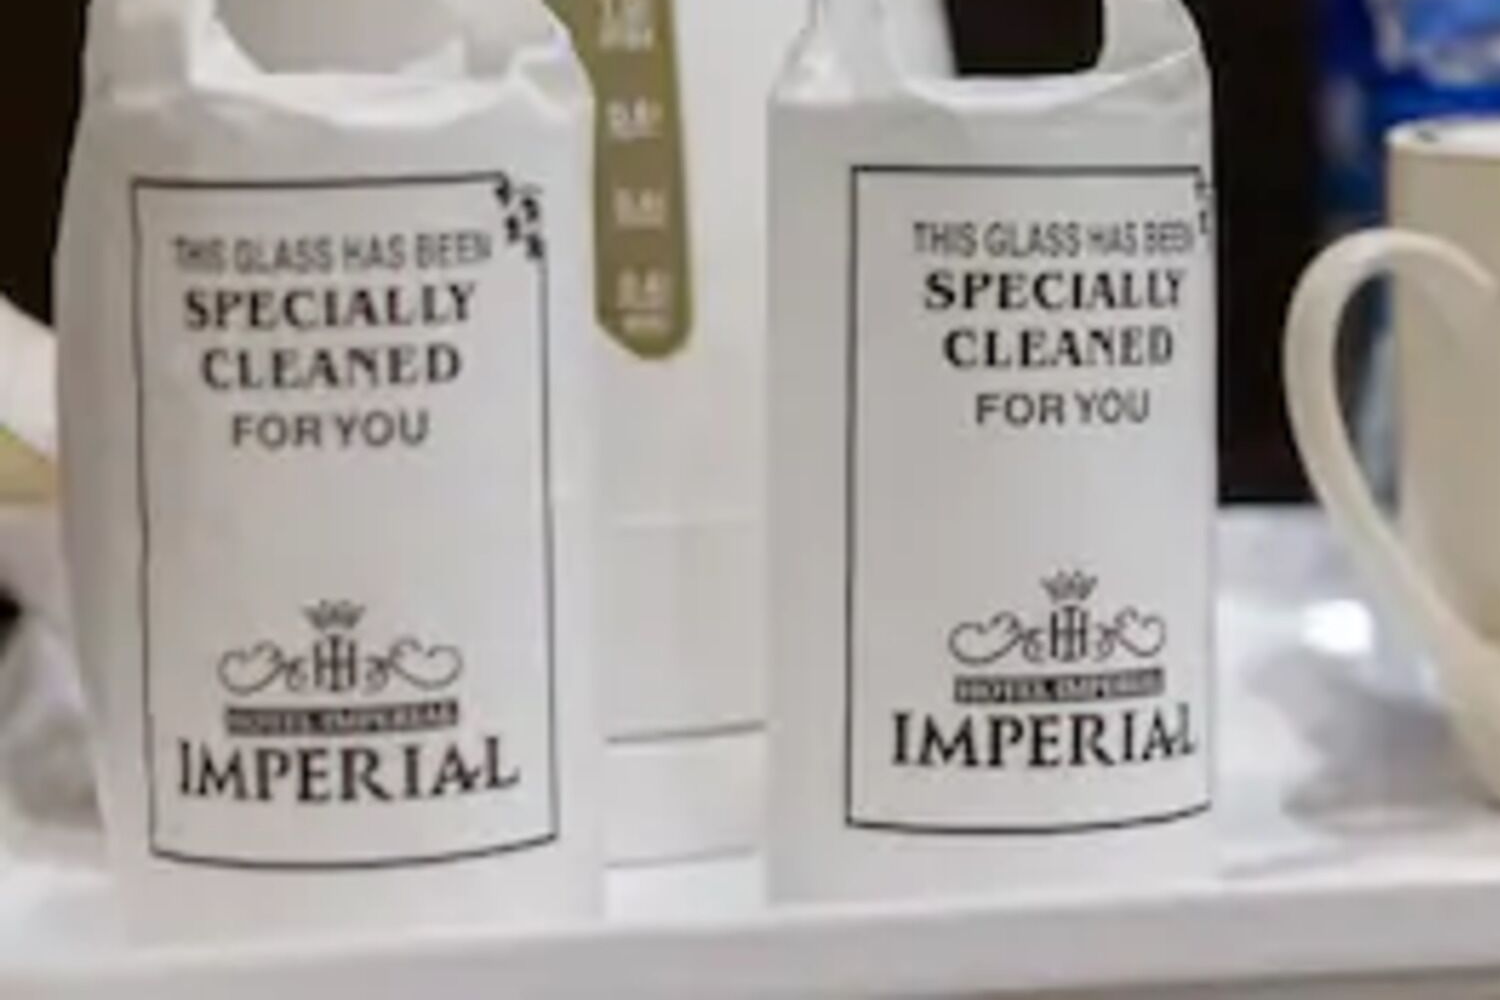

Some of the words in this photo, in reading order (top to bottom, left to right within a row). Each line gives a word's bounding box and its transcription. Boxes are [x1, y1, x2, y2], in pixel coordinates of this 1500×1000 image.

[173, 235, 226, 272] THIS
[233, 236, 332, 274] GLASS
[342, 234, 406, 272] HAS
[415, 230, 493, 268] BEEN
[910, 221, 977, 258] THIS
[983, 221, 1081, 258] GLASS
[1088, 222, 1138, 257] HAS
[184, 283, 476, 330] SPECIALLY
[924, 267, 1186, 311] SPECIALLY
[202, 343, 462, 390] CLEANED
[942, 325, 1174, 368] CLEANED
[231, 414, 323, 449] FOR
[335, 410, 430, 447] YOU
[974, 390, 1066, 427] FOR
[1074, 388, 1151, 425] YOU
[892, 702, 1197, 768] IMPERIAL
[177, 737, 520, 801] IMPERIAL
